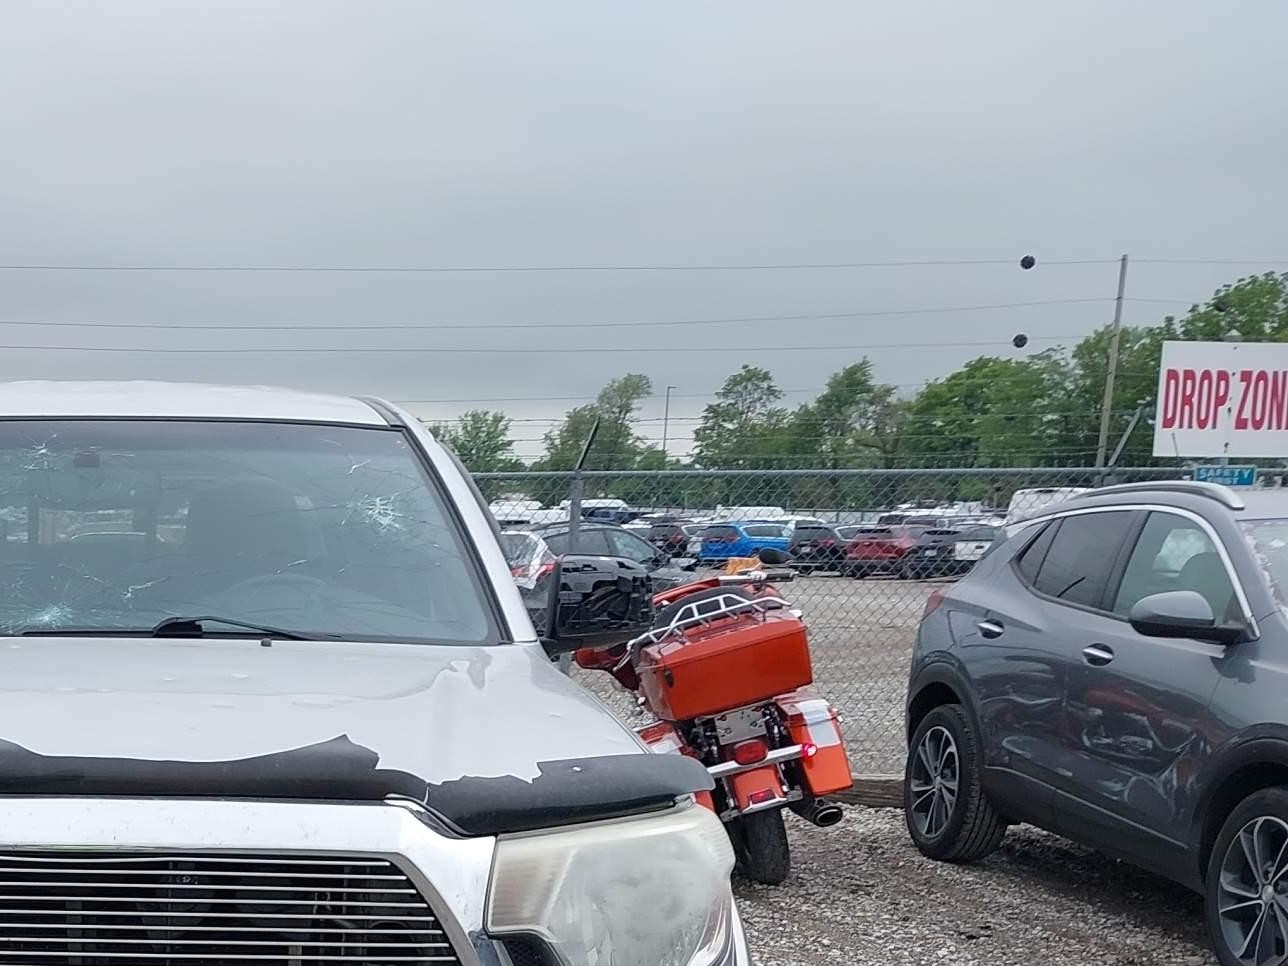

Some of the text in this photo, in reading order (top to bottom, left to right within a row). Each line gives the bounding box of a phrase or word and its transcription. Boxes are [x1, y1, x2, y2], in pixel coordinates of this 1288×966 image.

[1162, 369, 1288, 431] DROP ZON
[1199, 468, 1252, 479] SAFETY
